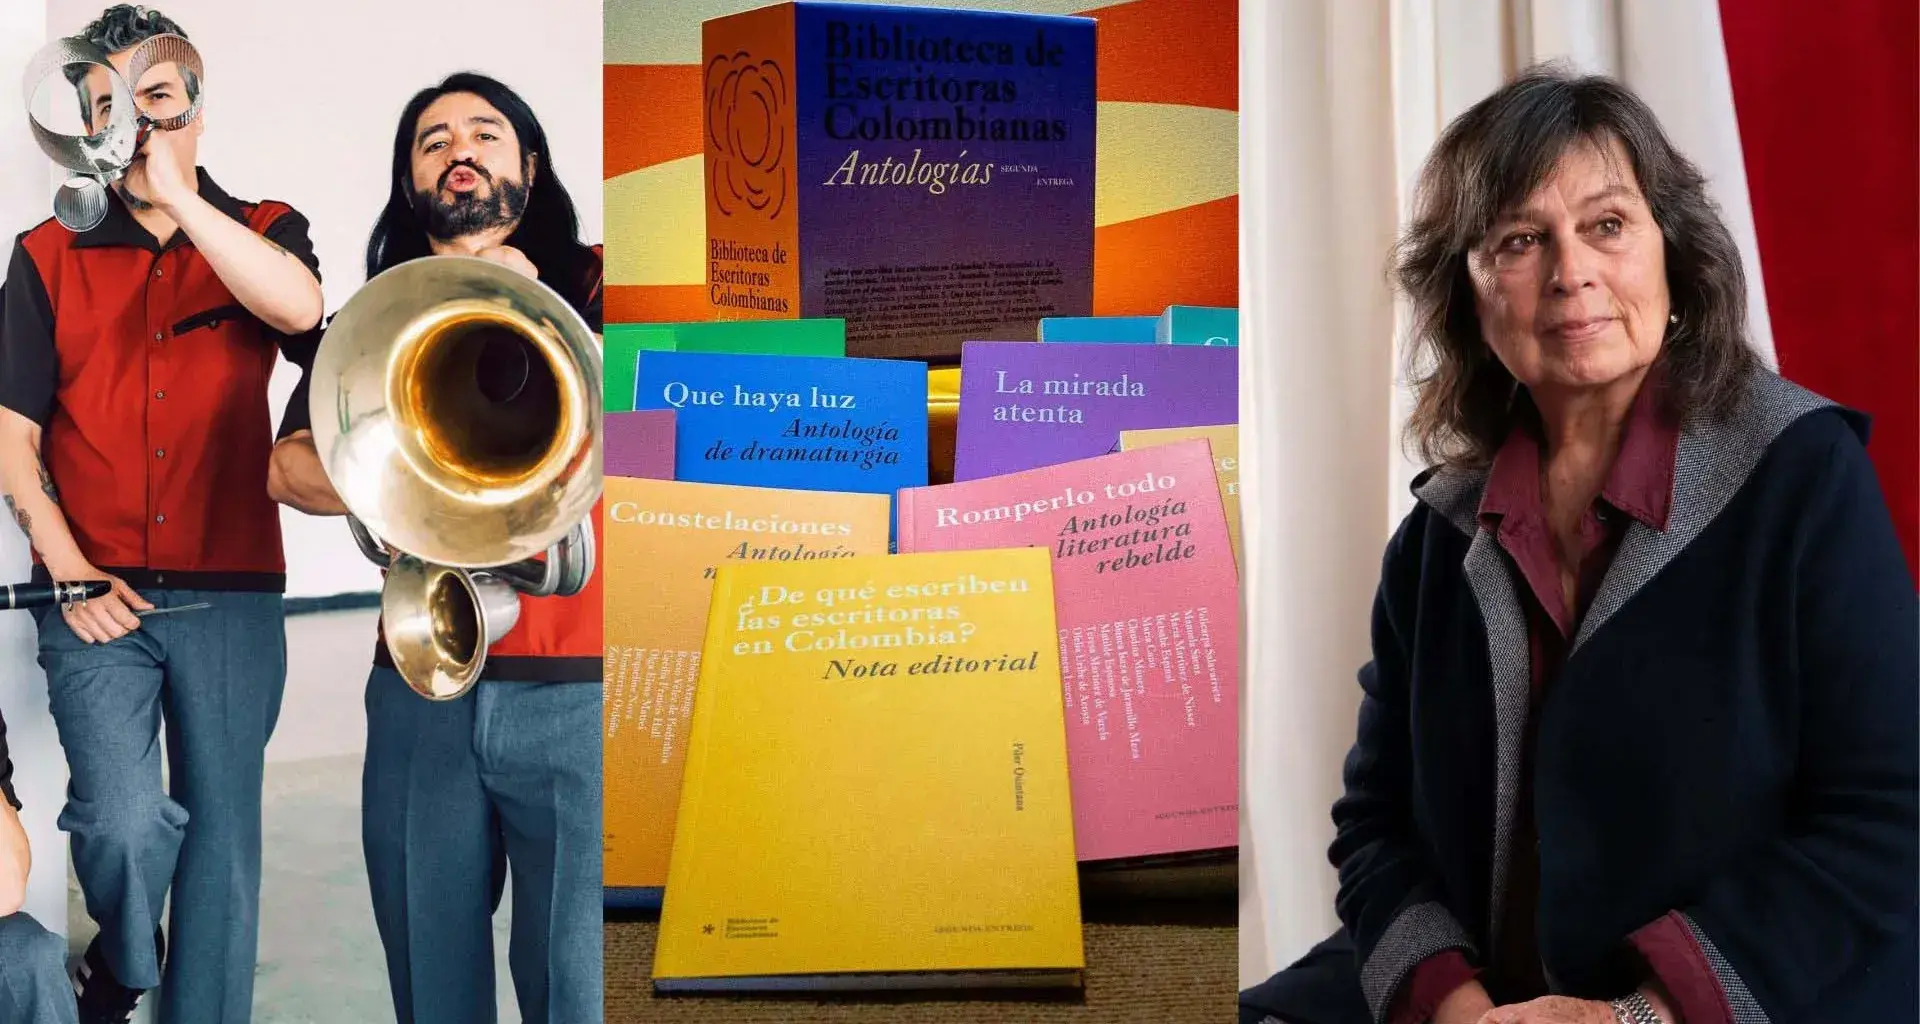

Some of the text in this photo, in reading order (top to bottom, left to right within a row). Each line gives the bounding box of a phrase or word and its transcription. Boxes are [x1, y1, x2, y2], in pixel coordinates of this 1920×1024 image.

[824, 21, 1065, 67] Biblioteca de
[825, 64, 1018, 103] Escritoras
[823, 104, 1067, 142] Colombianas
[823, 149, 994, 195] Antologías
[1000, 164, 1039, 173] SEGUNDA
[1036, 177, 1074, 186] ENTREGA
[711, 238, 787, 264] Biblioteca de
[711, 261, 770, 286] Escritoras
[711, 283, 789, 313] Colombianas
[663, 382, 857, 412] Que haya luz
[995, 371, 1146, 397] La mirada
[993, 404, 1084, 424] atenta
[783, 418, 899, 447] Antología
[704, 441, 900, 470] de dramaturgia
[936, 472, 1176, 528] Romperlo todo
[609, 502, 852, 536] Constelaciones
[1058, 498, 1186, 537] Antología
[1056, 521, 1192, 559] literatura
[1095, 543, 1196, 574] rebelde
[738, 574, 1029, 615] ¿De qué escriben
[736, 604, 961, 632] las escritoras
[733, 622, 977, 656] en Colombia?
[822, 651, 1039, 680] Nota editorial
